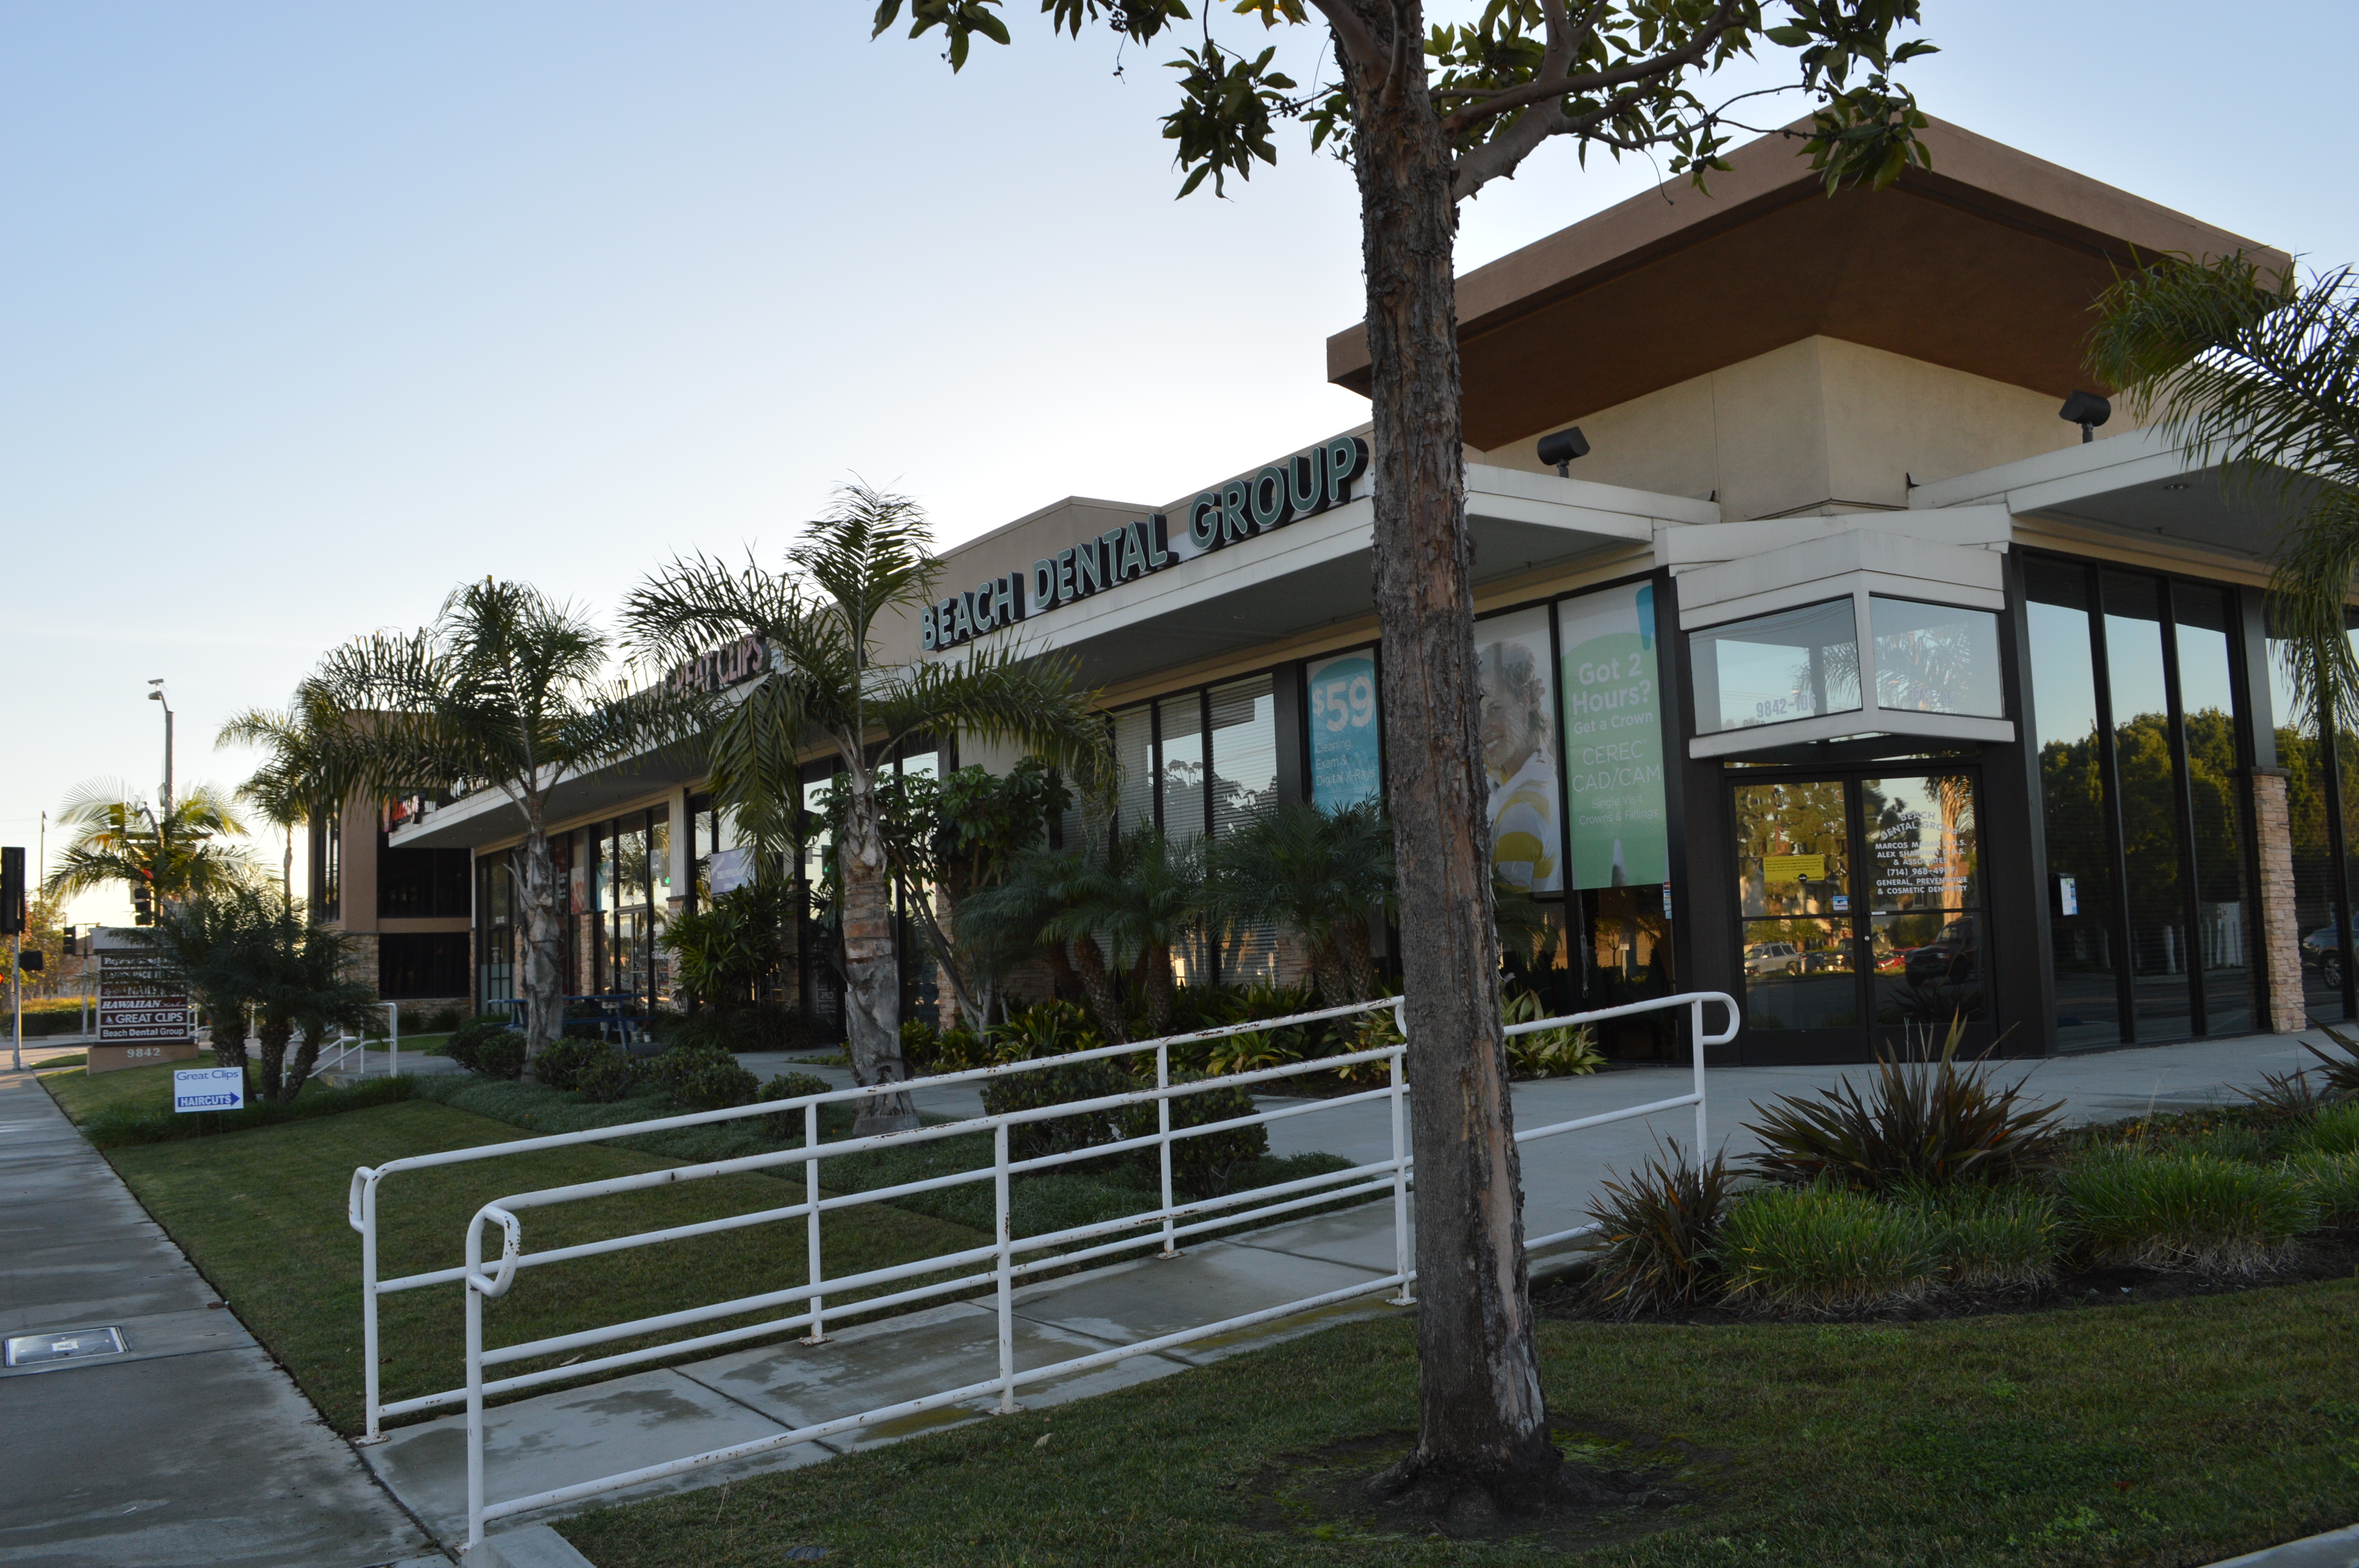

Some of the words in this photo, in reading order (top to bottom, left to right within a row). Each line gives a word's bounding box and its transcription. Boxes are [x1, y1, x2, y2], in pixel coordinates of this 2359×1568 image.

[920, 572, 1016, 651] BEACH
[1032, 513, 1169, 610] DENTAL
[1187, 435, 1359, 550] GROUP
[716, 629, 763, 684] CLIPS
[1578, 658, 1620, 686] Got
[1629, 653, 1642, 677] 2
[1312, 676, 1375, 732] $59
[1572, 679, 1652, 716] Hours?
[1756, 693, 1817, 718] 9842-106
[1574, 719, 1596, 734] Get
[1599, 719, 1608, 730] a
[1611, 712, 1654, 729] Crown
[1315, 739, 1353, 754] Cleaning,
[1583, 740, 1644, 766] CEREC
[1315, 758, 1339, 770] Exam
[1341, 754, 1348, 766] &
[1316, 770, 1344, 787] Digital
[1346, 769, 1376, 781] X-Rays
[1572, 764, 1662, 792] CAD/CAM
[1592, 796, 1620, 809] Single
[1622, 794, 1643, 805] Visit
[1579, 814, 1613, 825] Crowns
[1616, 811, 1622, 822] &
[1625, 809, 1658, 820] Fillings
[1900, 811, 1936, 821] BEACH
[1880, 821, 1918, 840] DENTAL
[1920, 821, 1958, 835] GROUP
[1875, 841, 1908, 850] MARCOS
[1886, 868, 1908, 877] (714)
[1876, 878, 1913, 887] GENERAL,
[1916, 876, 1968, 885] PREVENTATIVE
[1928, 884, 1968, 893] DENTISTRY
[101, 999, 162, 1009] HAWAIIAN
[115, 1013, 152, 1024] GREAT
[155, 1012, 184, 1023] CLIPS
[102, 1029, 128, 1037] Beach
[129, 1028, 158, 1036] Dental
[159, 1028, 185, 1036] Group
[127, 1047, 161, 1058] 9842
[176, 1071, 209, 1081] Great
[211, 1069, 239, 1080] Clips
[180, 1094, 232, 1107] HAIRCUTS
